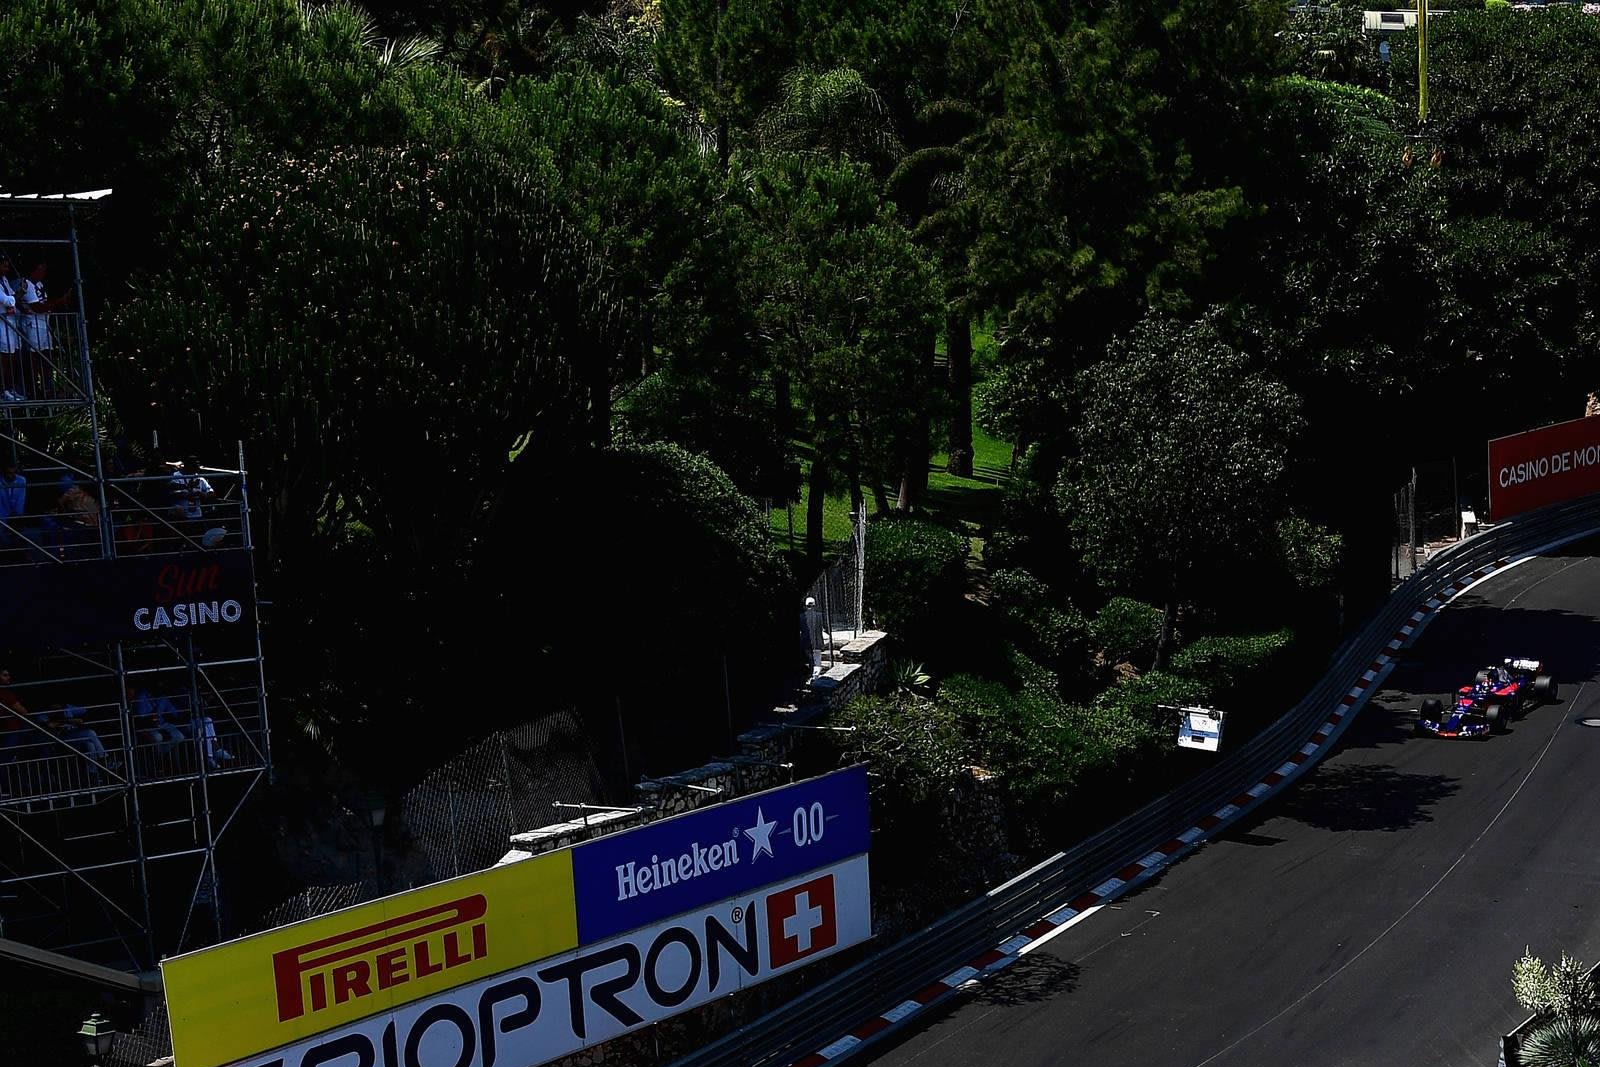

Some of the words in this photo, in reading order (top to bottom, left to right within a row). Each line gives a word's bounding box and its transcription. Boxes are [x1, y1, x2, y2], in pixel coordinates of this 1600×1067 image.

[1499, 456, 1548, 488] CASINO
[1551, 451, 1571, 474] DE
[153, 562, 220, 604] Sun
[133, 599, 242, 631] CASINO
[615, 838, 740, 901] Heineken
[272, 893, 488, 1023] PIRELLI
